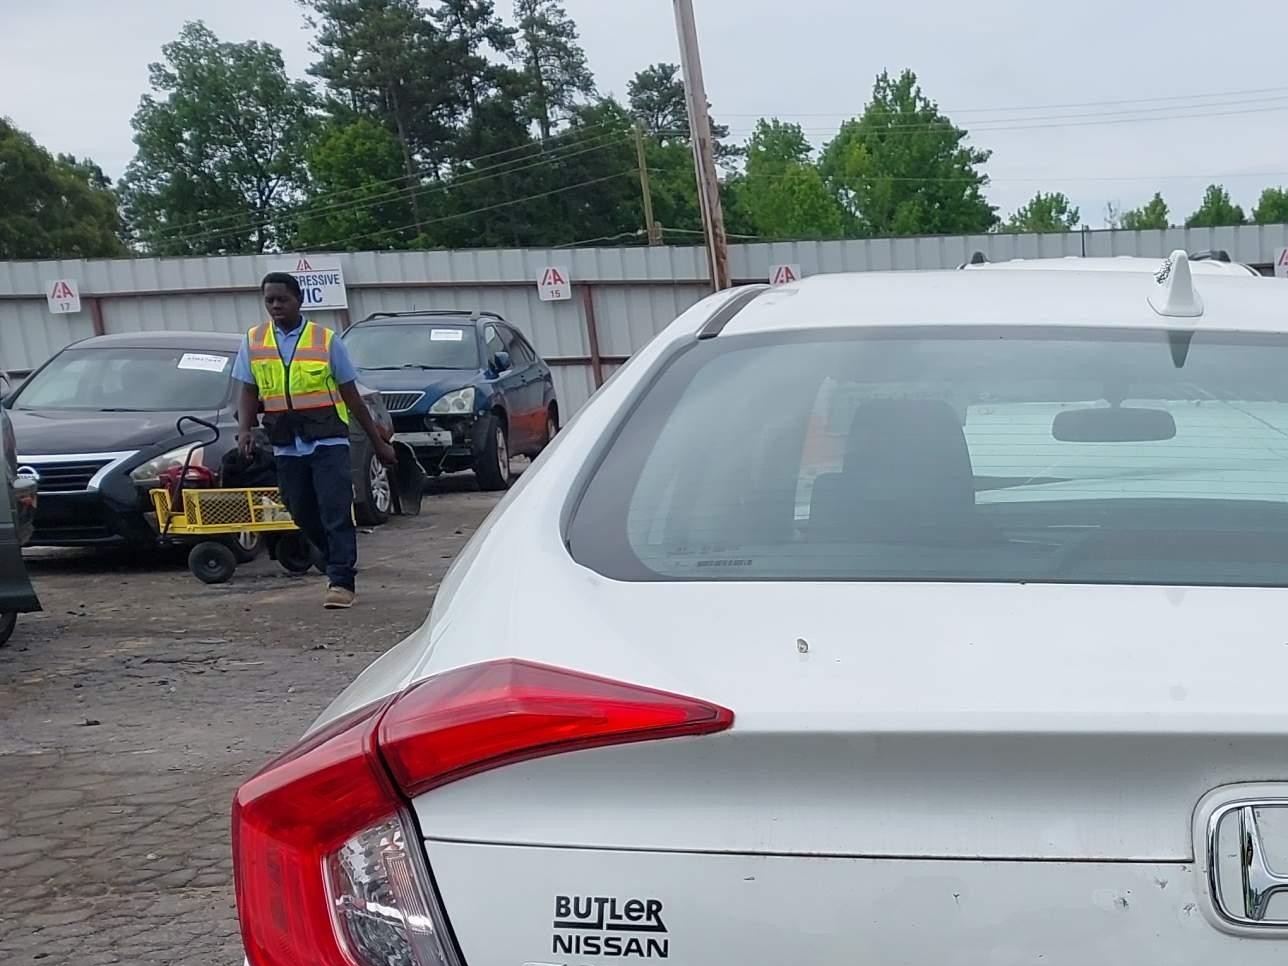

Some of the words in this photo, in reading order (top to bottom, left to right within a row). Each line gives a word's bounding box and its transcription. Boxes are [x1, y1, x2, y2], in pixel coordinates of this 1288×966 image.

[550, 289, 561, 298] 15
[60, 302, 70, 311] 17
[552, 934, 669, 958] NISSAN
